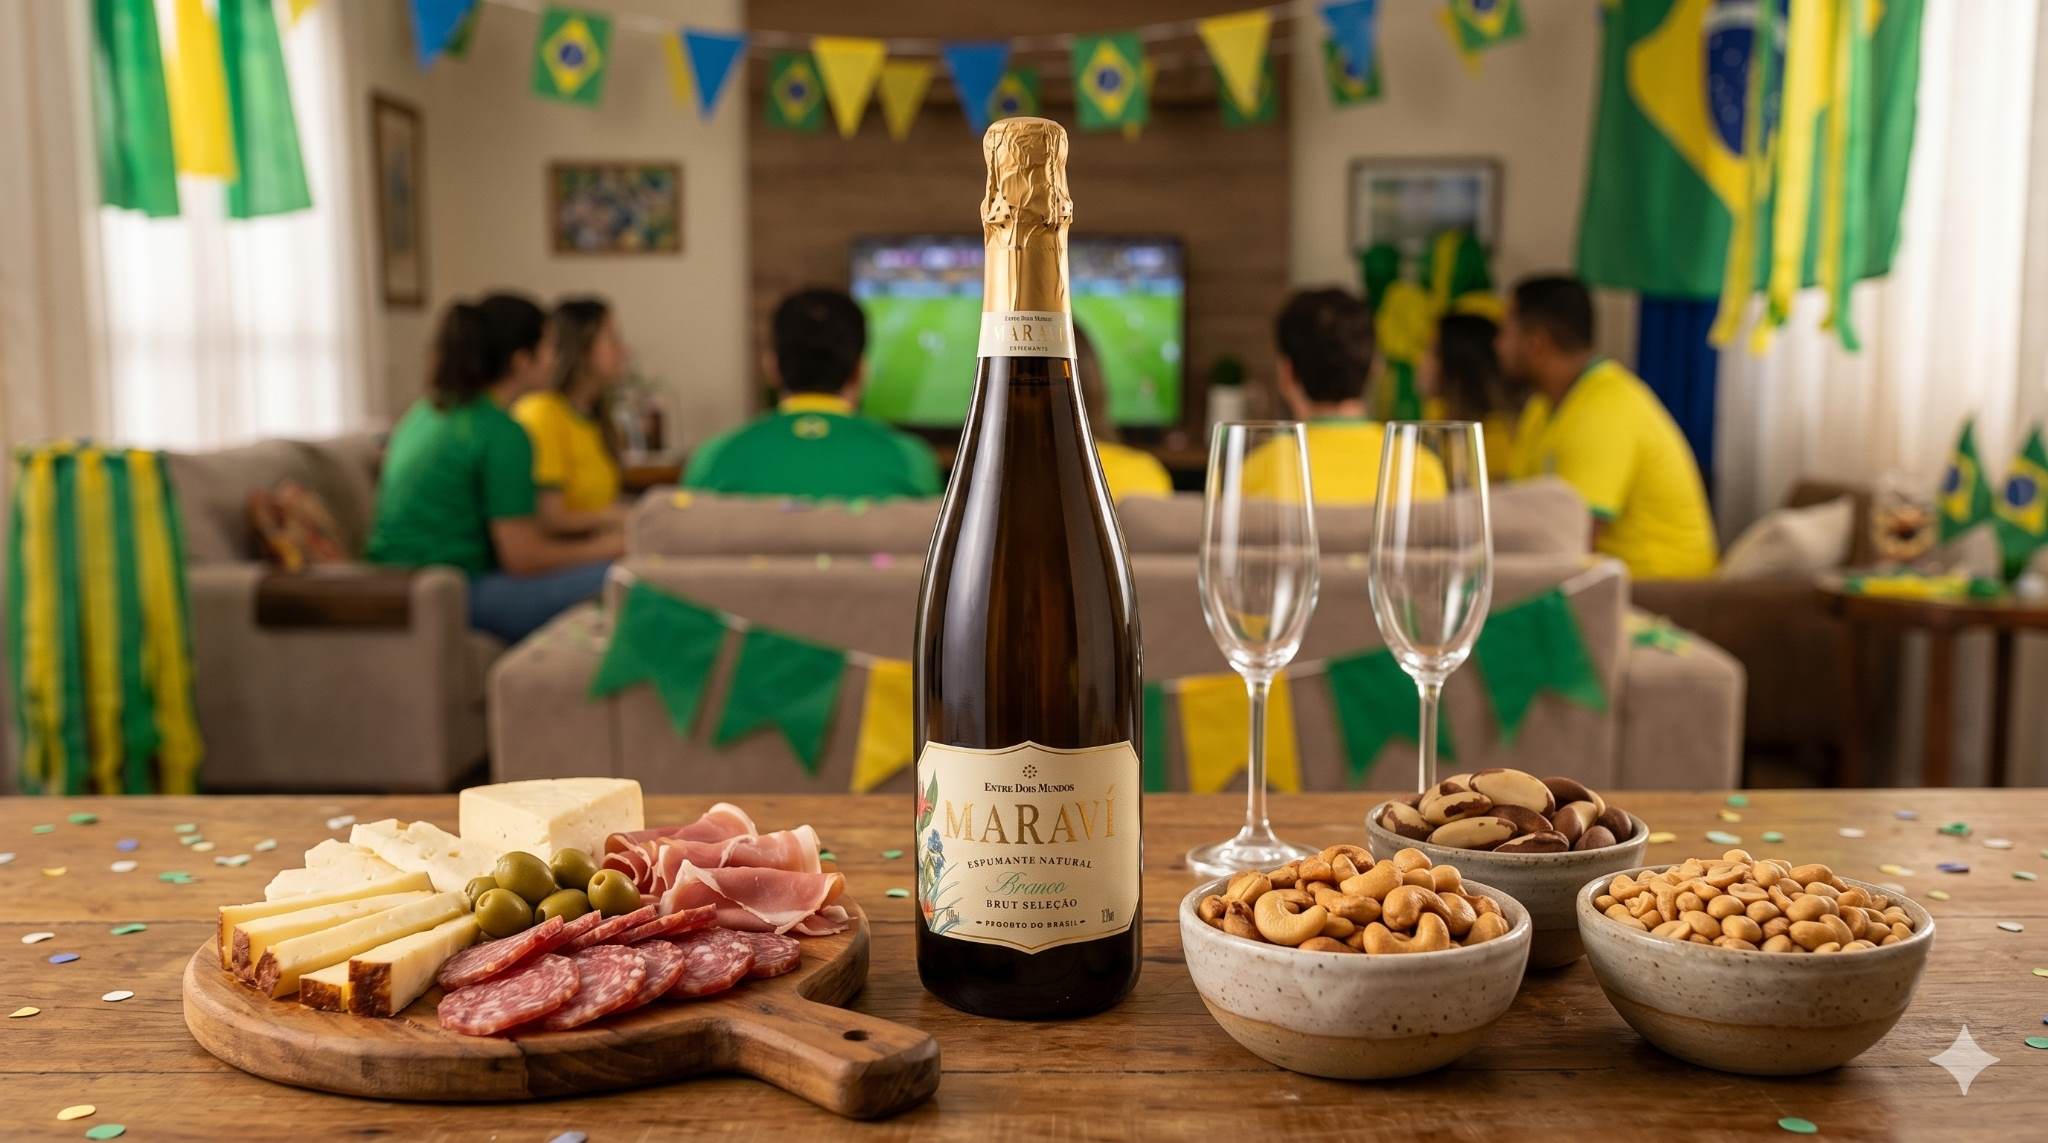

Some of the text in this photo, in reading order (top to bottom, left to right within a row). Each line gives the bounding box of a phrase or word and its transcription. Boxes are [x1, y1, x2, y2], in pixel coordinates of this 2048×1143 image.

[984, 782, 1075, 793] ENTRE DOIS MUNDOS
[944, 784, 1117, 845] MARAVÍ
[968, 856, 1093, 869] ESPUMANTE NATURAL
[985, 871, 1068, 896] Branco
[986, 898, 1078, 911] BRUT SELEÇÃO
[1030, 921, 1044, 929] DO
[1047, 919, 1078, 928] BRASIL
